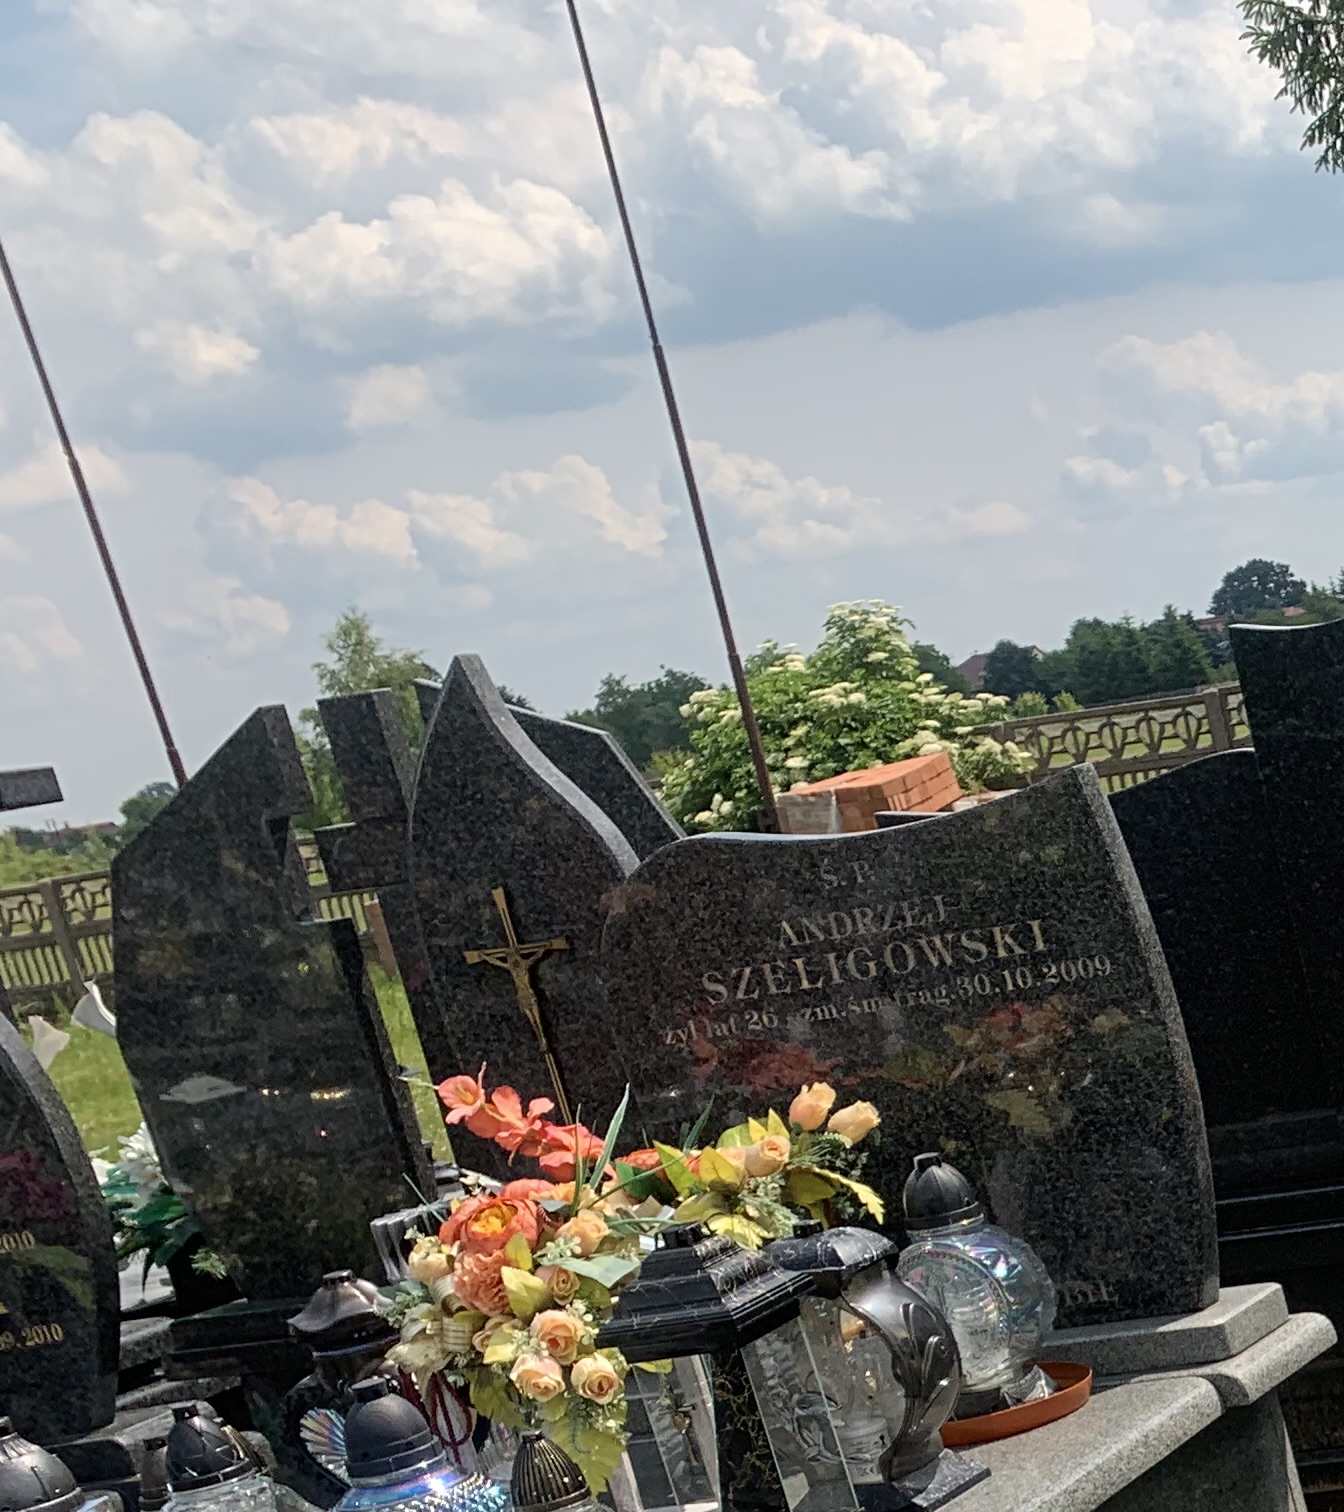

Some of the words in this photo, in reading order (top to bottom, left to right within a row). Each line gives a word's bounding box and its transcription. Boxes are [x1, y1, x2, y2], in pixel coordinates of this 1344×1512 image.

[778, 893, 949, 948] ANDRZEJ
[701, 919, 1047, 1005] SZELIGOWSKI
[744, 1007, 778, 1031] 26
